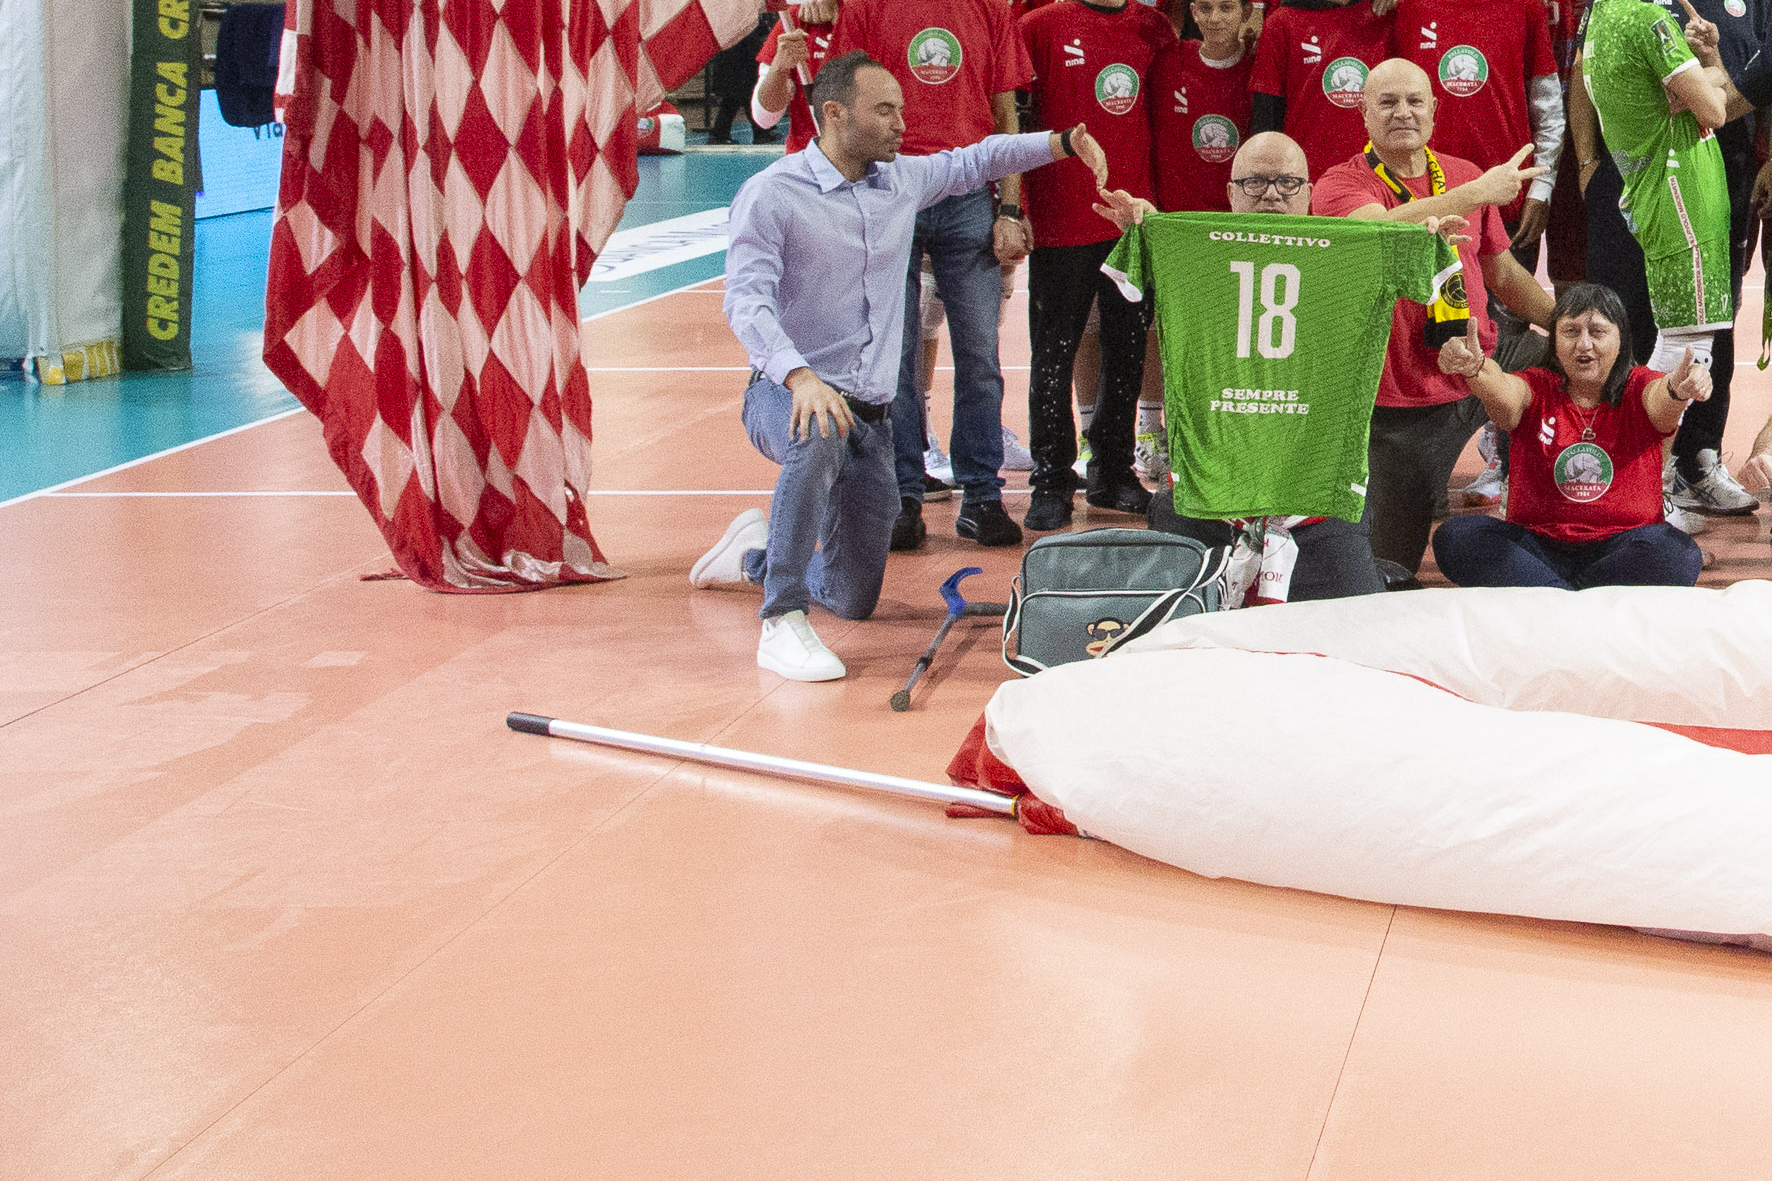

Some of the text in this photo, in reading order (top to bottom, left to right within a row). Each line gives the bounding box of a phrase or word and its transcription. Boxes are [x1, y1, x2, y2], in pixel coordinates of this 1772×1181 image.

[1420, 40, 1437, 50] nine
[1064, 57, 1085, 68] nine
[1303, 55, 1322, 65] nine
[153, 61, 188, 187] BANCA
[1208, 230, 1332, 249] COLLETTIVO
[146, 199, 183, 341] CREDEM
[1229, 260, 1301, 359] 18
[1221, 387, 1300, 403] SEMPRE
[1210, 399, 1310, 415] PRESENTE
